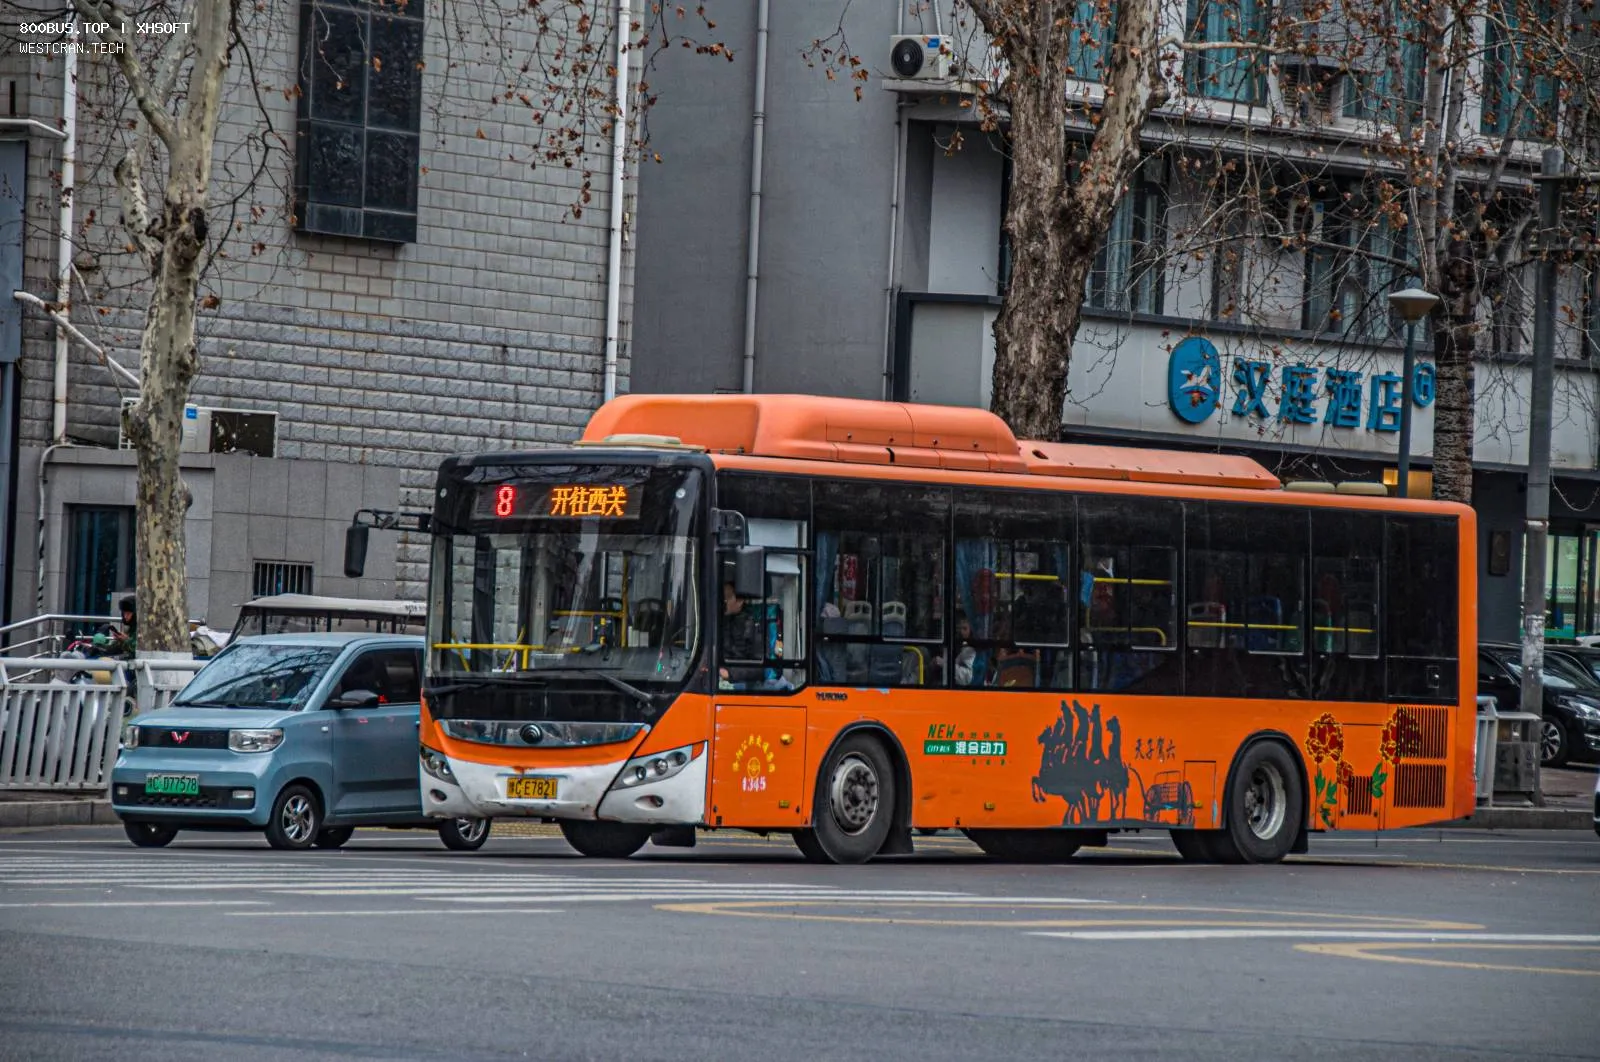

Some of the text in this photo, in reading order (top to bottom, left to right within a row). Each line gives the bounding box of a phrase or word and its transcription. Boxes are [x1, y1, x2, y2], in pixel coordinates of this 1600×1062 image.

[1231, 356, 1402, 432] 汉庭酒店
[496, 486, 515, 517] 8
[551, 486, 627, 516] 开往西关
[928, 723, 956, 739] NEW
[955, 741, 1005, 755] 混合动力
